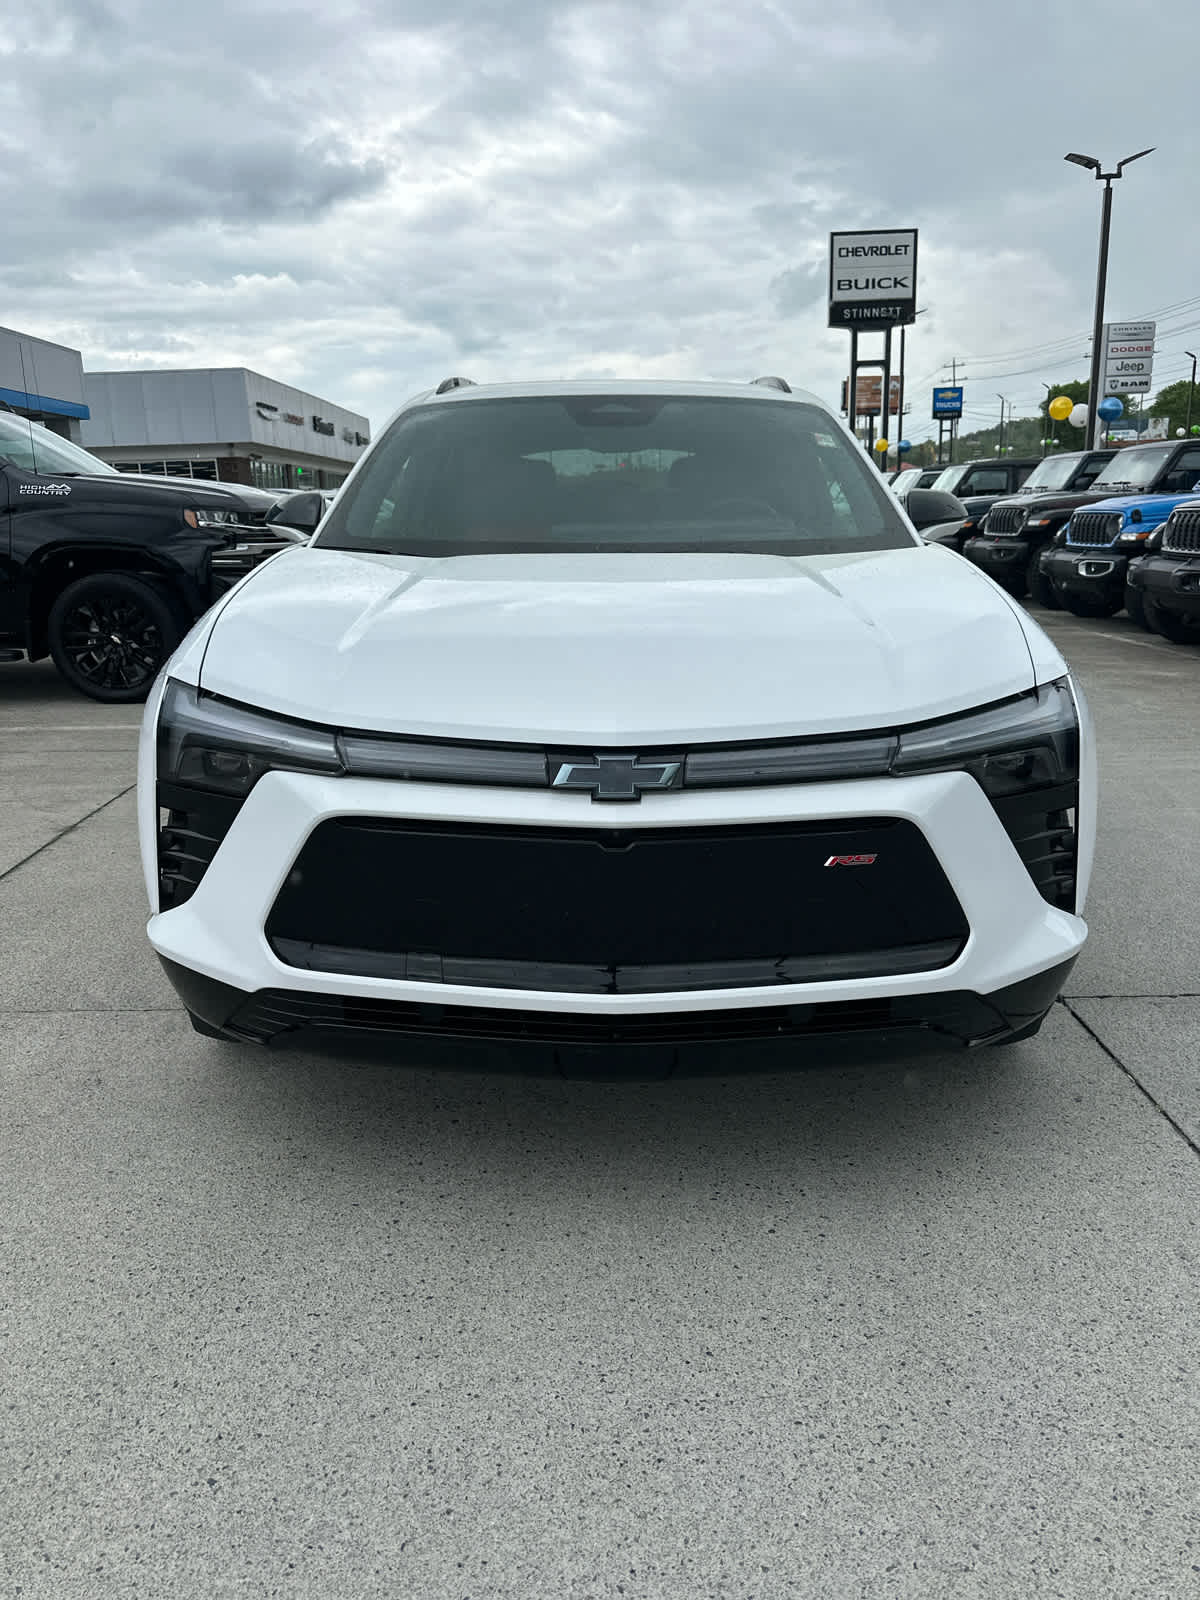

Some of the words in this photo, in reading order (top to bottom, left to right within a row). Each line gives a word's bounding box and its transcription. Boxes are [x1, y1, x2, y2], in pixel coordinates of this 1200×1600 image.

[838, 244, 910, 258] CHEVROLET
[837, 276, 910, 291] BUICK
[843, 306, 902, 319] STINNETT
[1111, 345, 1152, 353] DODGE
[1115, 361, 1145, 373] Jeep
[823, 853, 878, 867] RS
